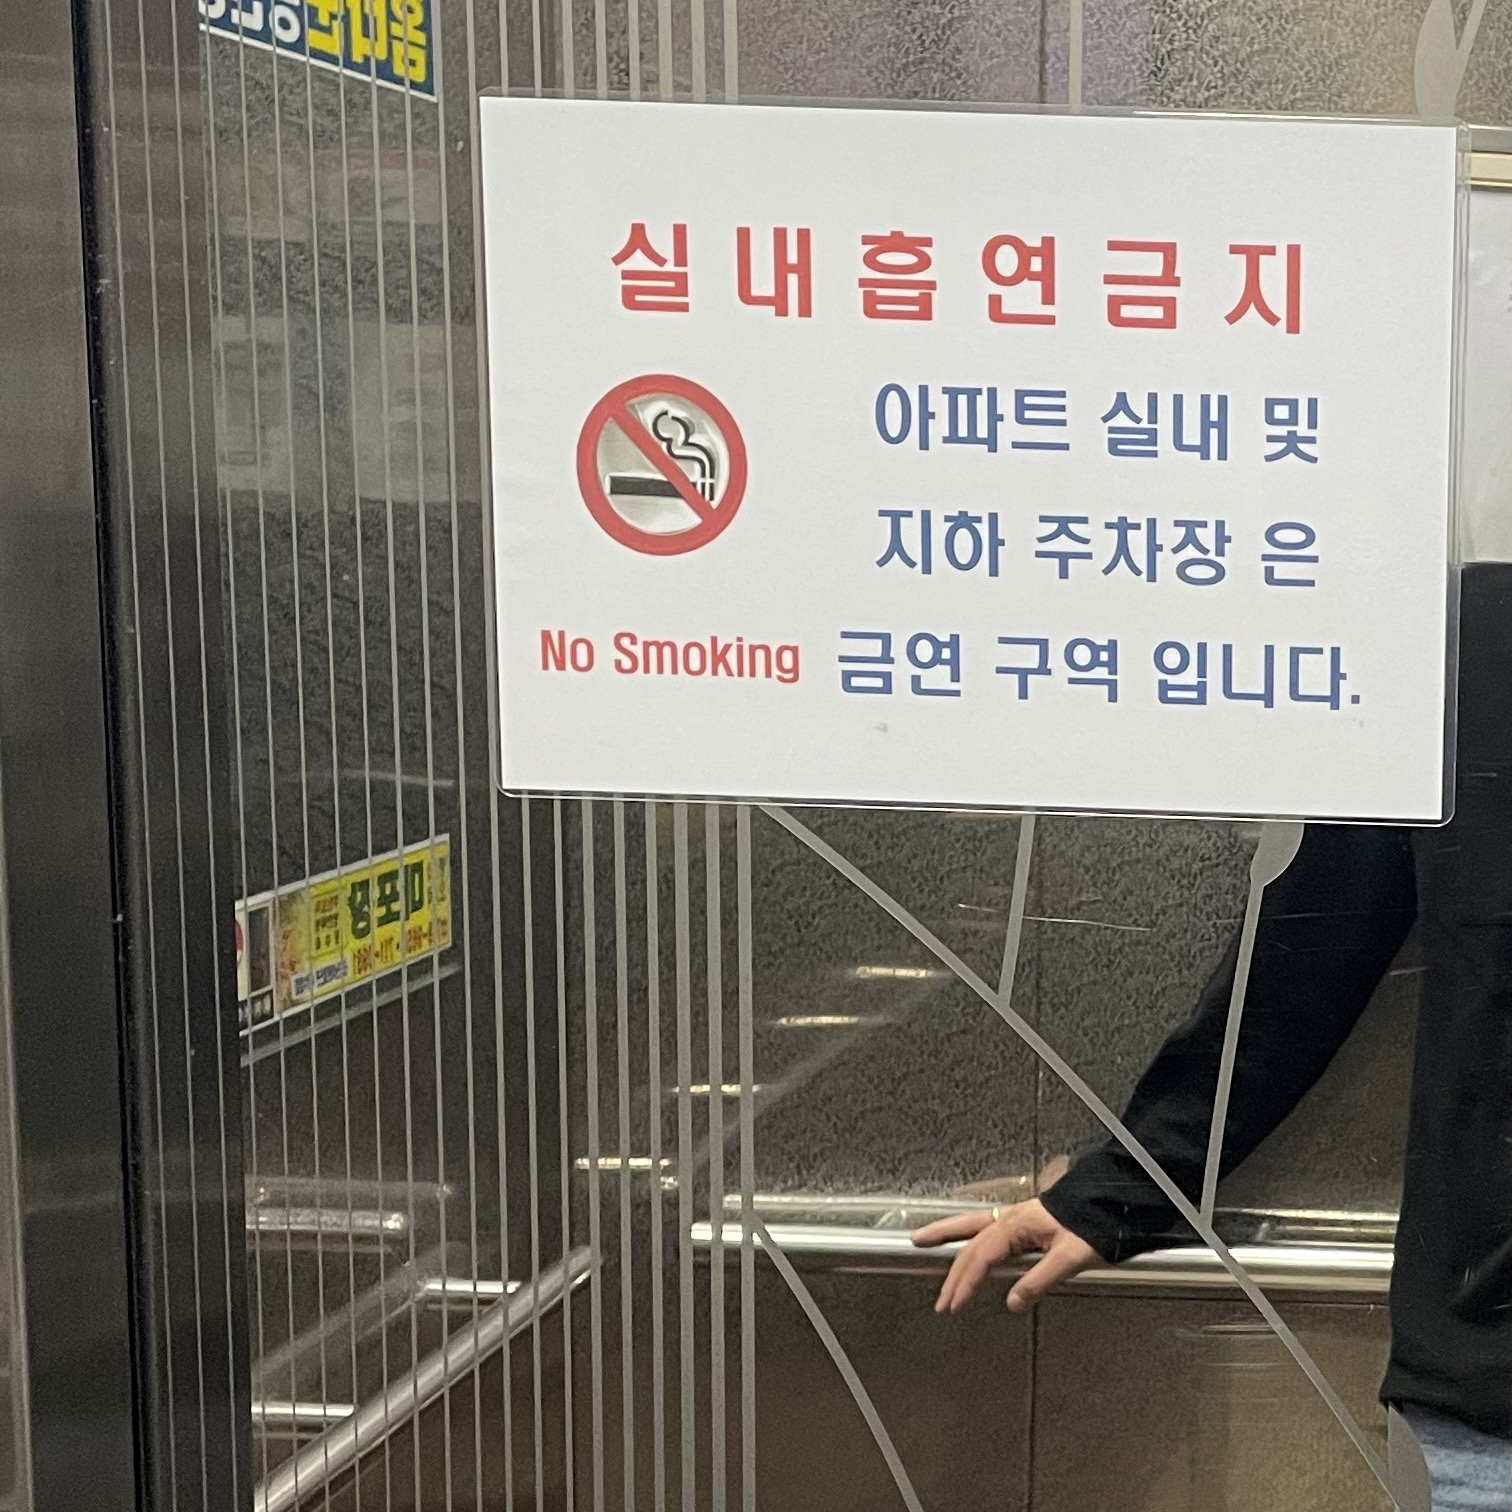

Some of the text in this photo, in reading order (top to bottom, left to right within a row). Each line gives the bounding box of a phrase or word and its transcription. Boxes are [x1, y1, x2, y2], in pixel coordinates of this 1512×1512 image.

[874, 382, 1319, 465] 아파트 실내 및
[875, 509, 1320, 588] 지하 주차장 은
[540, 628, 800, 685] No Smoking
[837, 630, 1361, 711] 금연 구역 입니다.
